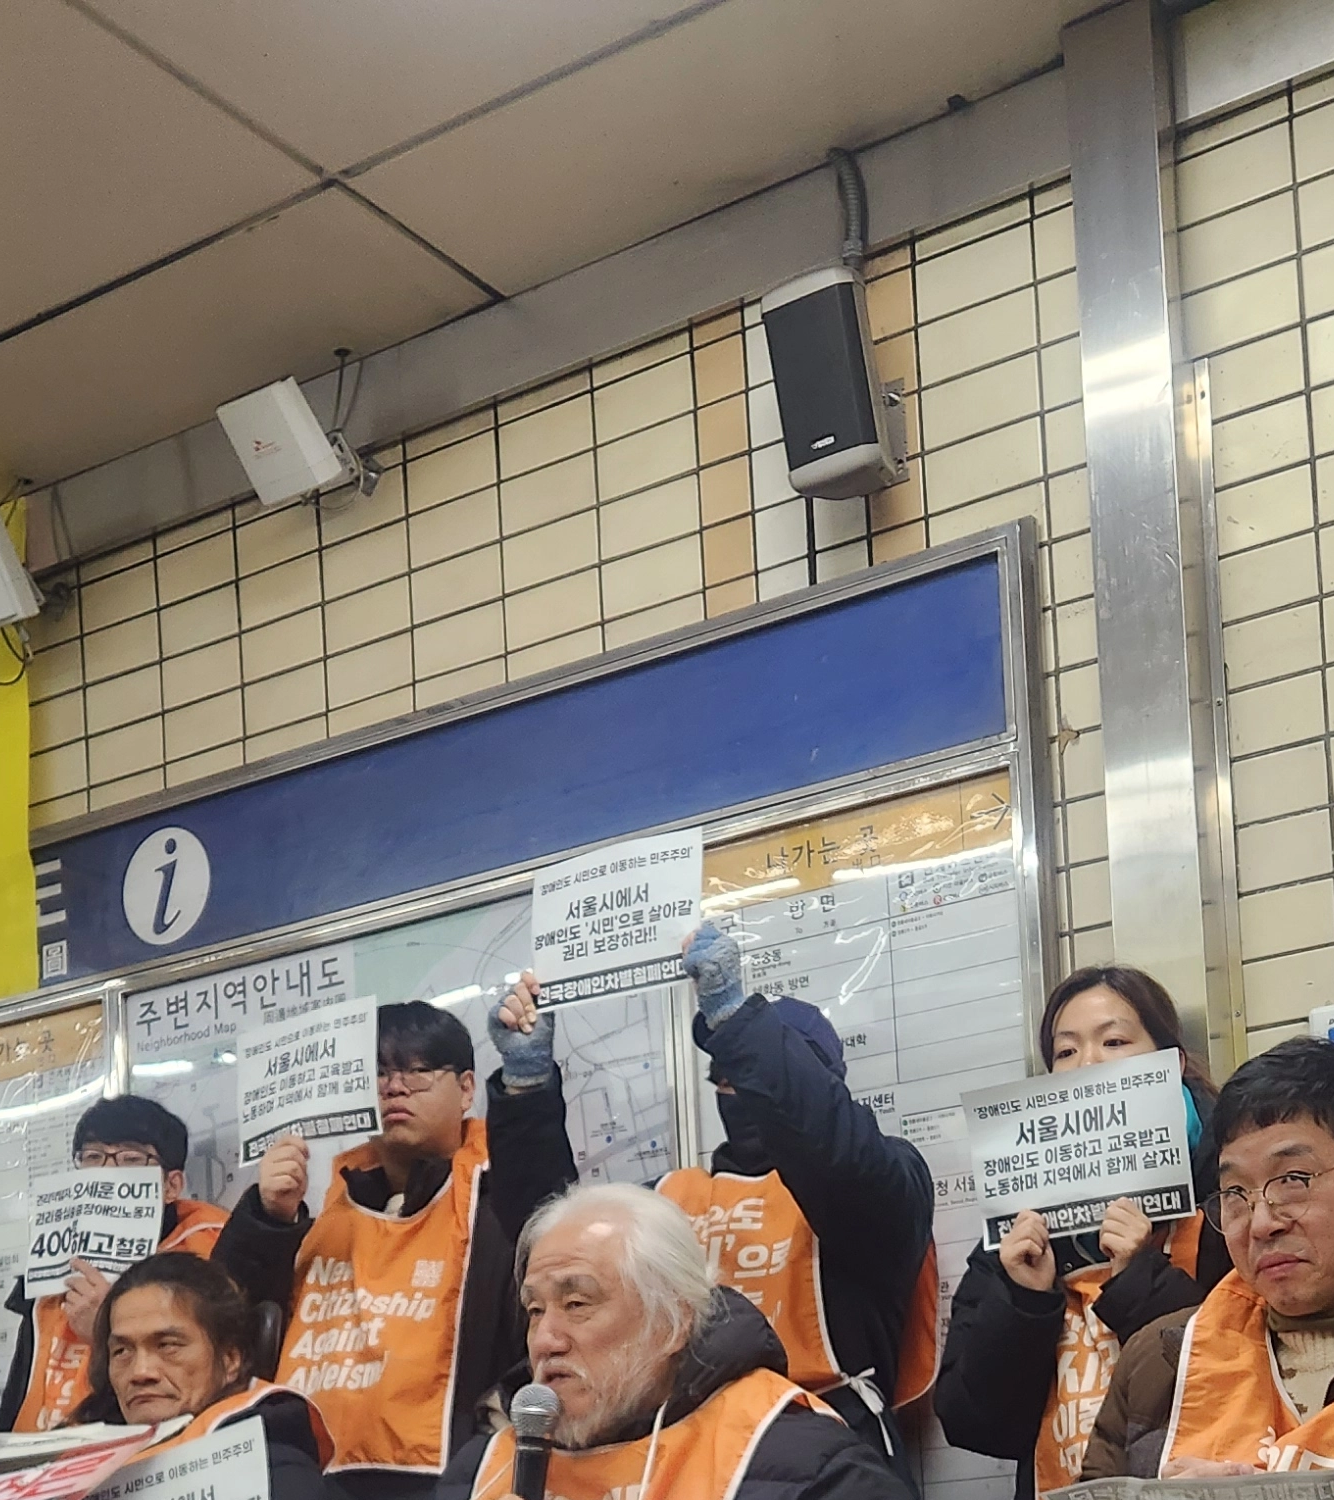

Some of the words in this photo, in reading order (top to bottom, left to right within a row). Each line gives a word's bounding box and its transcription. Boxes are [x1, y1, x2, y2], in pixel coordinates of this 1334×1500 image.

[573, 865, 607, 884] 시민으로
[610, 856, 647, 874] 이동하는
[565, 882, 650, 921] 서울시에서
[535, 924, 581, 951] 장애인도
[585, 910, 644, 937] '시민'으로
[648, 899, 694, 923] 살아갈
[562, 941, 589, 962] 권리
[593, 926, 657, 954] 보장하라!!
[136, 957, 346, 1037] 주변지역안내도
[788, 975, 810, 990] 방면
[136, 1025, 210, 1053] Neighborhood
[214, 1021, 237, 1036] Map
[264, 1037, 336, 1079] 서울시에서
[242, 1100, 274, 1124] 노동하며
[276, 1086, 313, 1108] 지역에서
[317, 1080, 339, 1098] 함께
[343, 1075, 370, 1093] 살자!
[244, 1081, 277, 1105] 장애인도
[280, 1068, 316, 1092] 이동하고
[320, 1058, 364, 1080] 교육받고
[973, 1099, 1023, 1121] '장애인도
[1025, 1090, 1070, 1111] 시민으로
[1073, 1079, 1117, 1100] 이동하는
[1120, 1068, 1171, 1091] 민주주의'
[1016, 1100, 1128, 1147] 서울시에서
[984, 1149, 1040, 1177] 장애인도
[1044, 1139, 1103, 1166] 이동하고
[1107, 1126, 1171, 1154] 교육받고
[984, 1173, 1038, 1199] 노동하며
[1043, 1163, 1102, 1189] 지역에서
[1106, 1155, 1138, 1176] 함께
[1143, 1147, 1182, 1170] 살자!
[73, 1181, 115, 1200] 오세훈
[117, 1182, 159, 1199] OUT!
[124, 1470, 165, 1494] 시민으로
[168, 1457, 210, 1480] 이동하는
